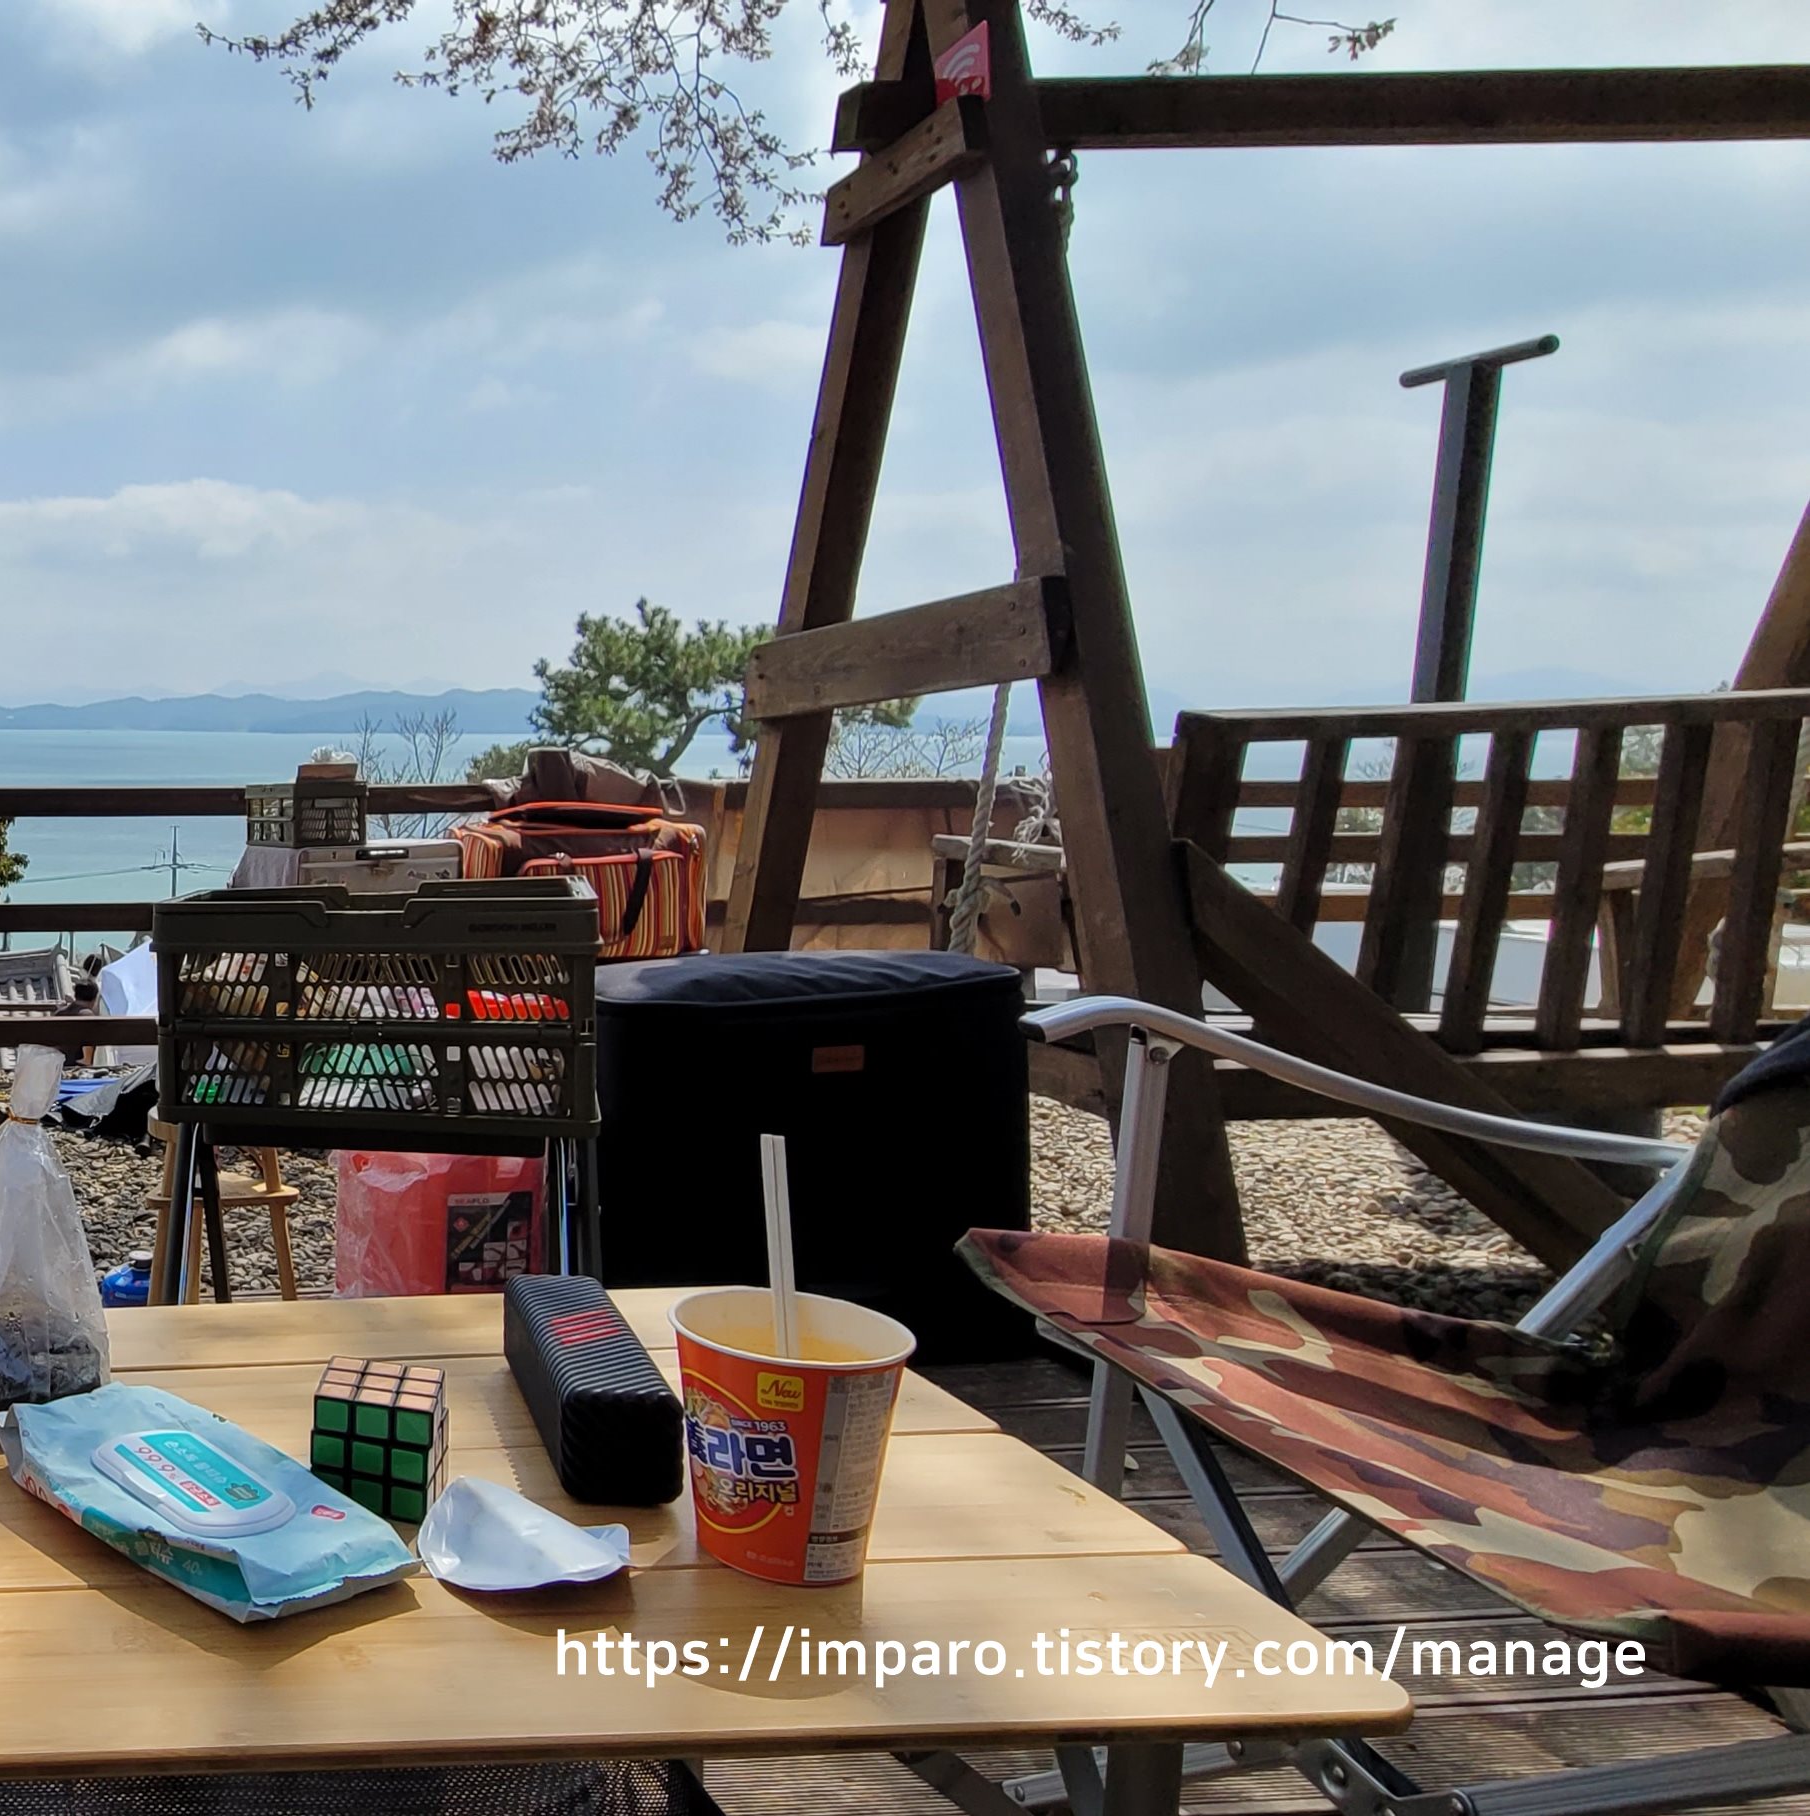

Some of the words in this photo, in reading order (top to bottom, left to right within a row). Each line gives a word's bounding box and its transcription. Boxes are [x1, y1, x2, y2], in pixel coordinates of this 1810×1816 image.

[760, 1380, 801, 1398] New
[754, 1421, 786, 1433] 1963
[719, 1479, 797, 1502] 오리지널
